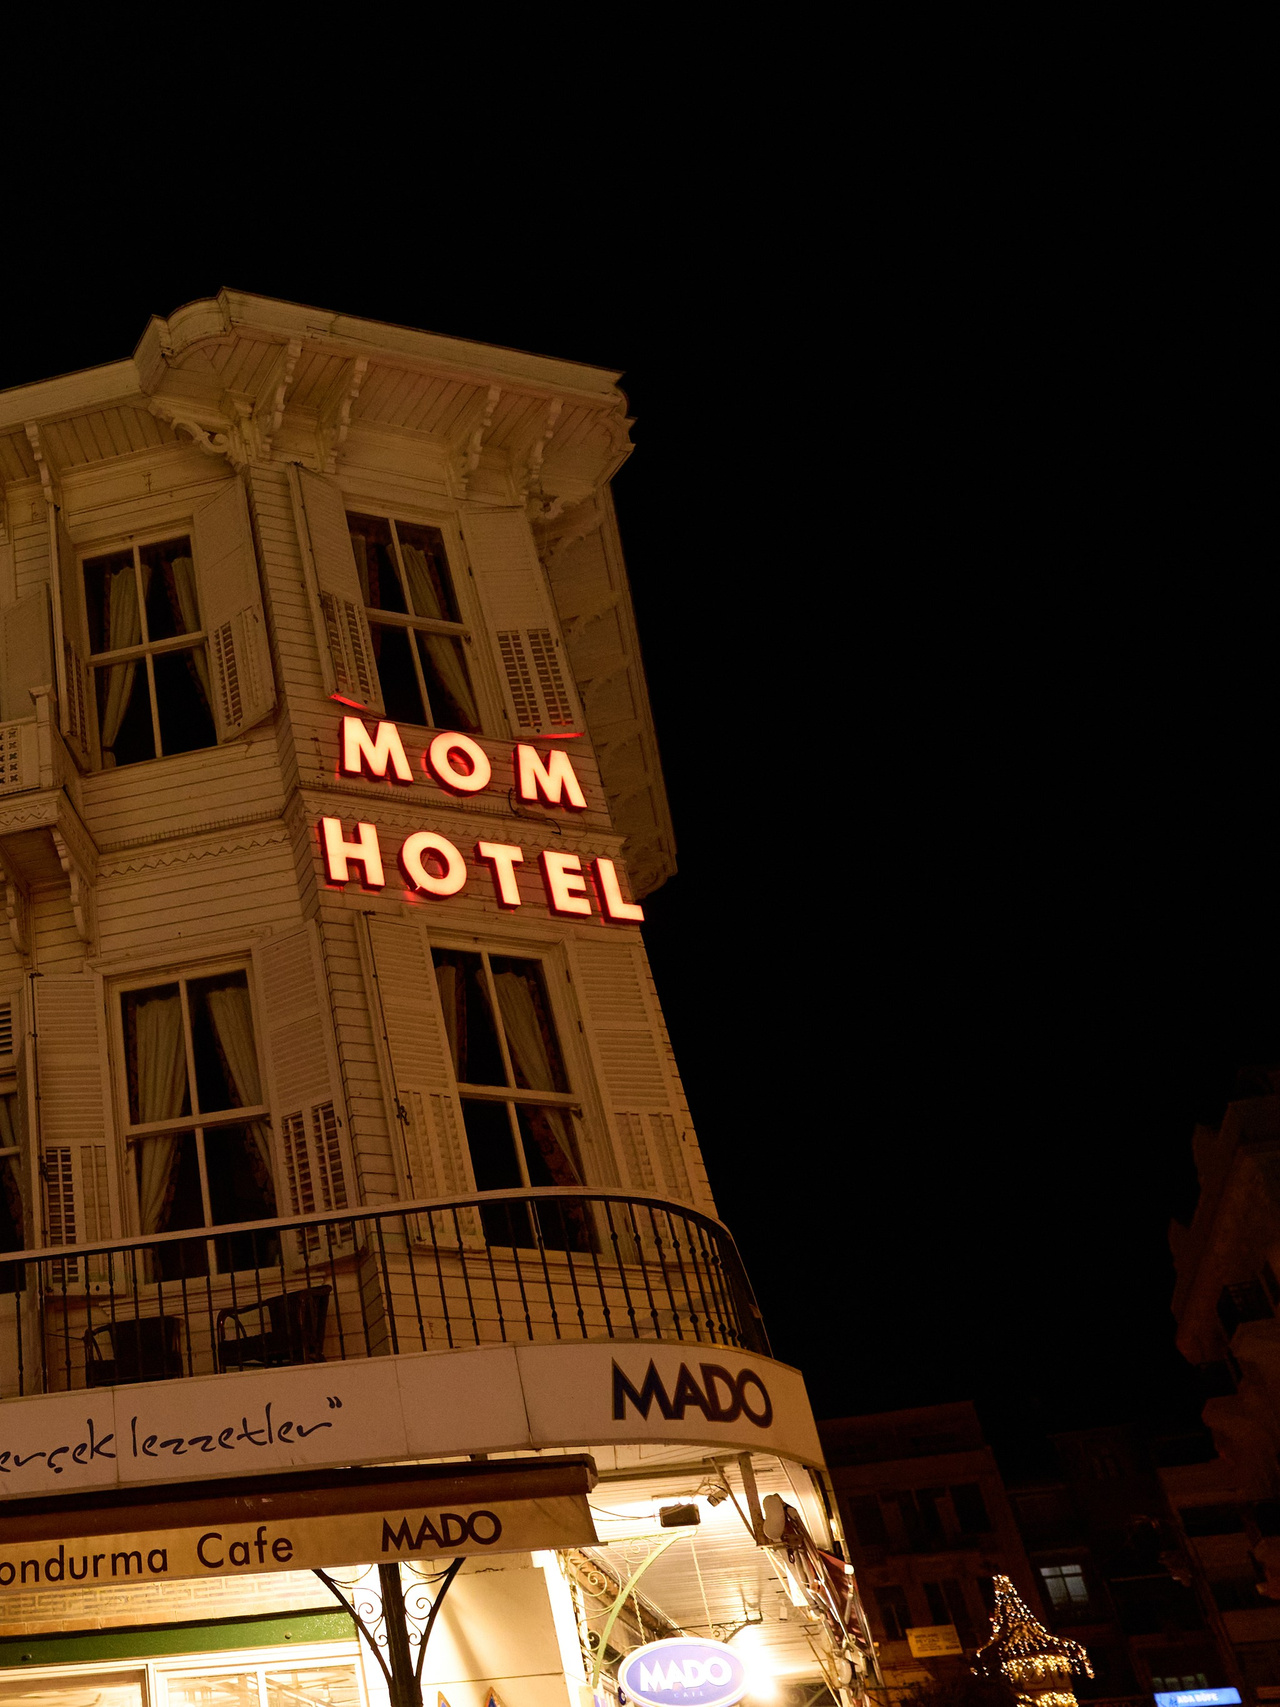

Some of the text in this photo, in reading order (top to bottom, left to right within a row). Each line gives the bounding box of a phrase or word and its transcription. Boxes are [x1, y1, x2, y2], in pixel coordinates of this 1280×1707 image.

[339, 716, 588, 812] MOM
[320, 817, 645, 923] HOTEL
[610, 1357, 773, 1429] MADO
[196, 1526, 294, 1567] Cafe
[381, 1510, 503, 1553] MADO
[639, 1656, 733, 1692] MADO
